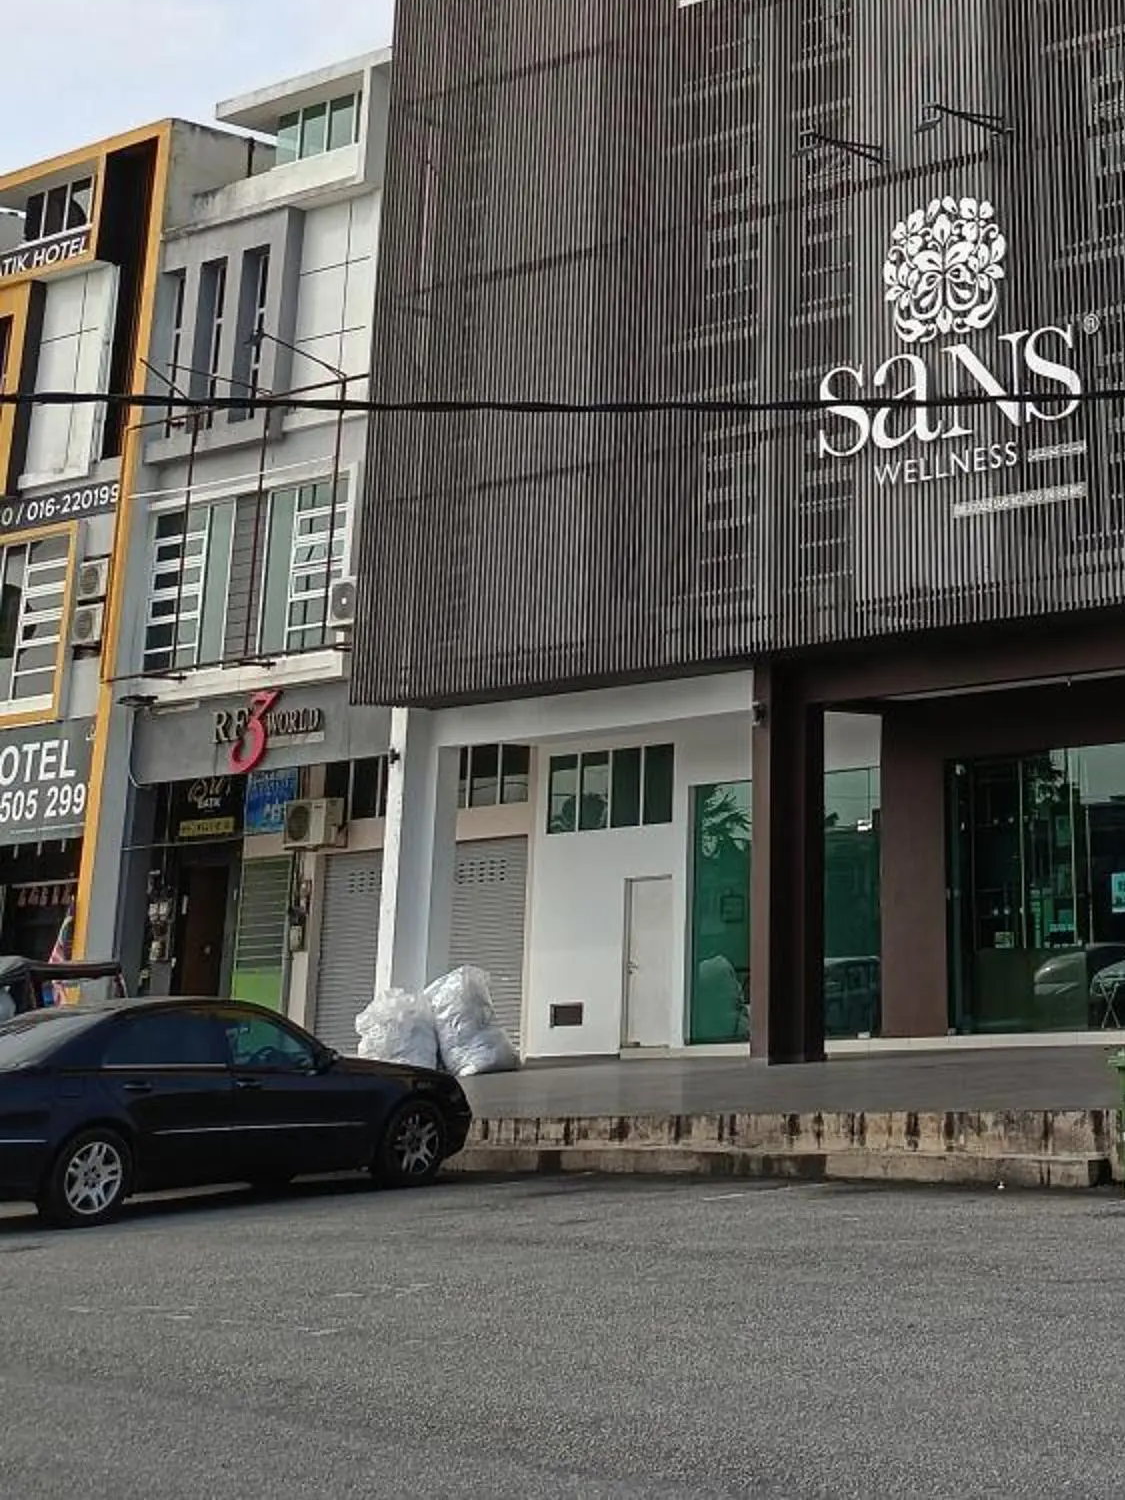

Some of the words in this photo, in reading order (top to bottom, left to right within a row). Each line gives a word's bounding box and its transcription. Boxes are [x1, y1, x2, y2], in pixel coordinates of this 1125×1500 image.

[0, 252, 30, 277] TIK
[32, 235, 88, 269] HOTEL
[874, 442, 1018, 486] WELLNESS
[44, 783, 87, 819] 299
